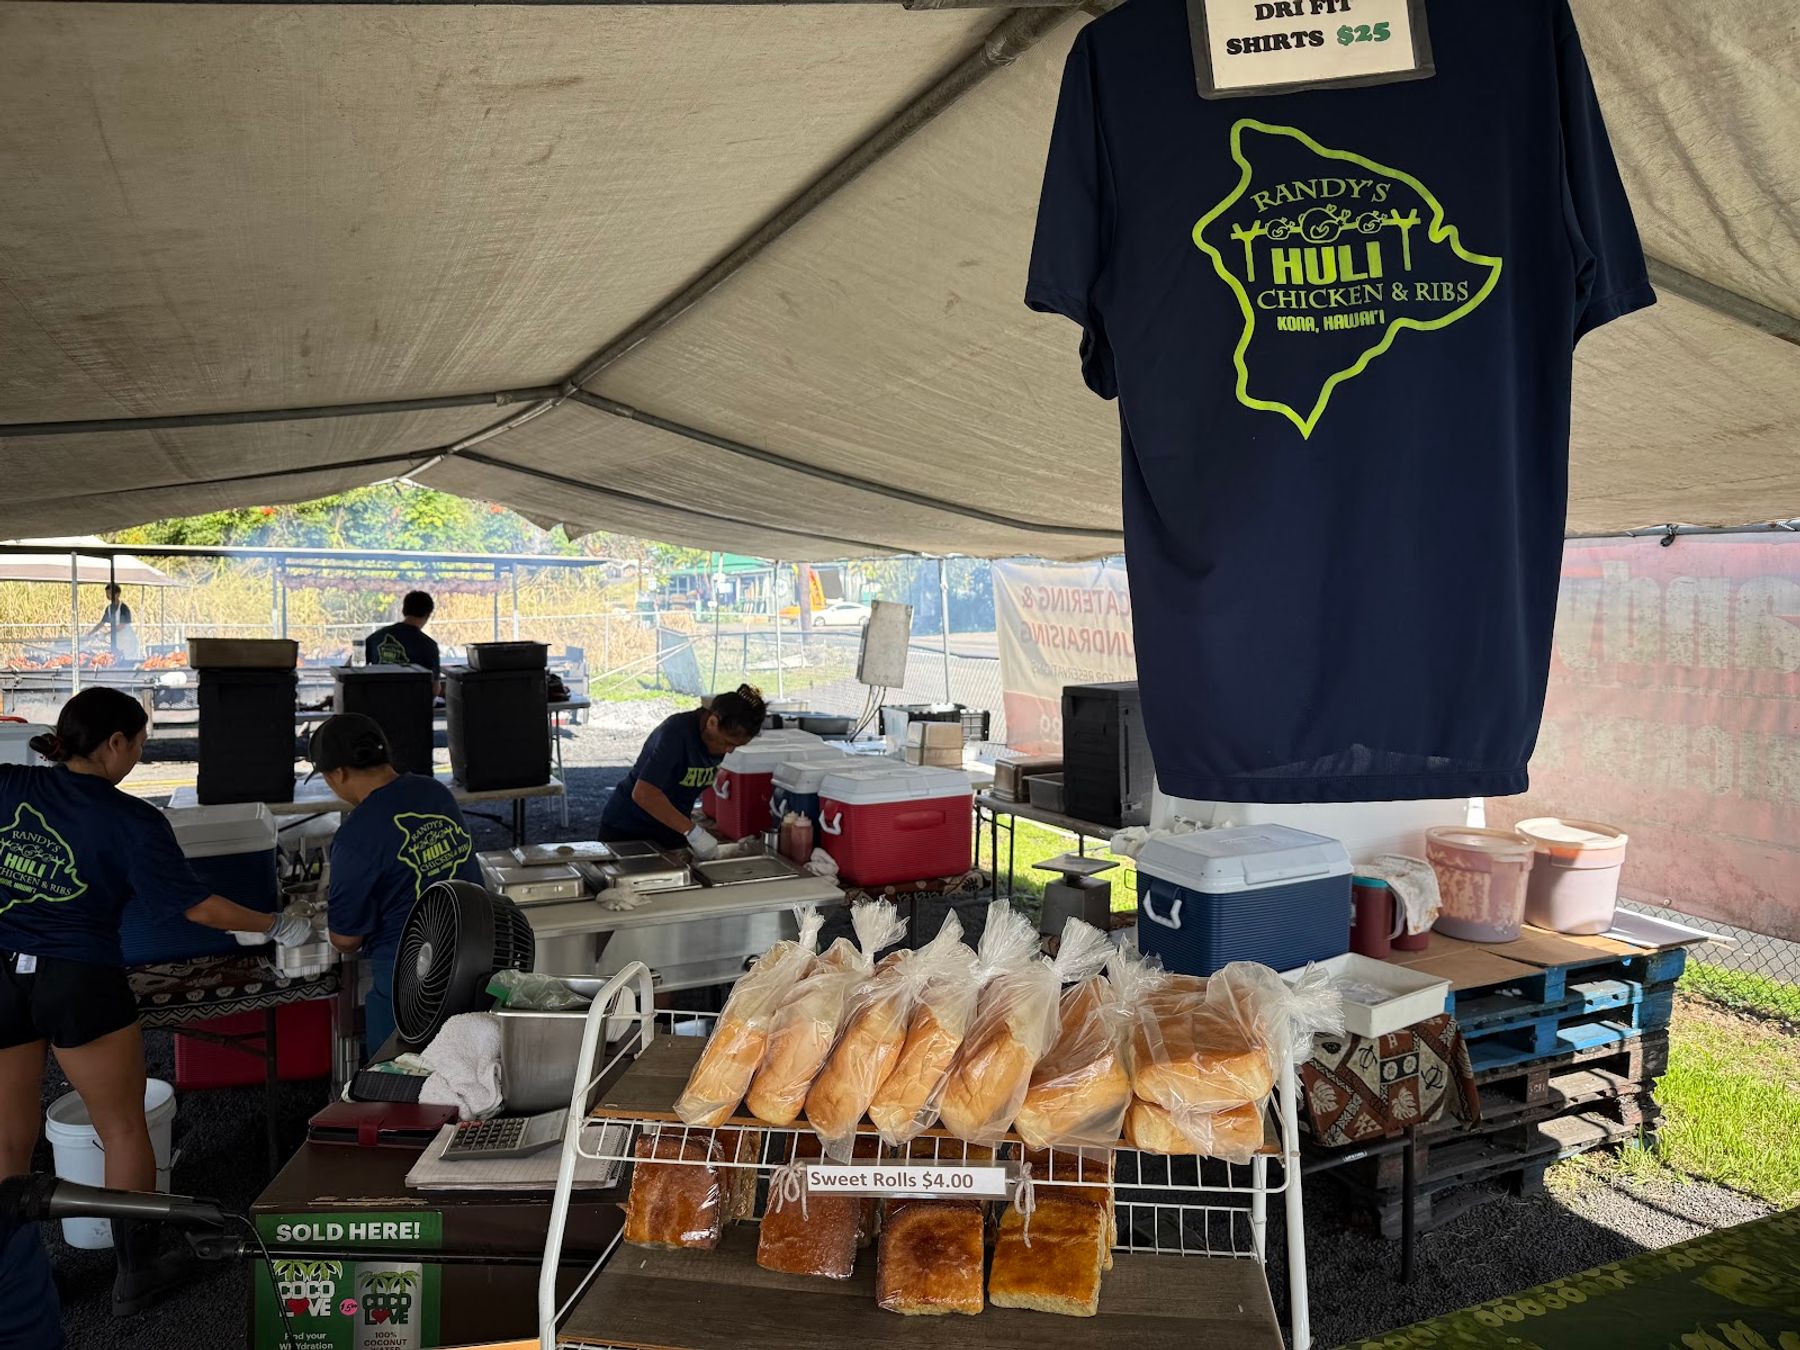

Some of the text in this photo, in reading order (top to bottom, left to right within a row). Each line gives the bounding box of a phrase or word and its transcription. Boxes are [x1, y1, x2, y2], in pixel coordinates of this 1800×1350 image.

[1254, 0, 1351, 21] DRI FIT
[1226, 21, 1391, 55] SHIRTS $25
[1250, 178, 1391, 213] RANDY'S
[1270, 241, 1383, 285] HULI
[1256, 280, 1469, 310] CHICKEN & RIBS
[12, 830, 61, 853] RANDY'S
[422, 839, 451, 863] HULI
[4, 852, 47, 878] HULI
[0, 866, 41, 886] HICKEN
[50, 883, 72, 896] RIBS
[811, 1171, 974, 1190] Sweet Rolls $4.00
[276, 1221, 420, 1242] SOLD HERE!
[278, 1280, 335, 1300] COCO
[362, 1293, 411, 1311] COCO
[284, 1332, 327, 1341] Fnd your
[363, 1338, 407, 1347] COCONUT
[375, 1331, 398, 1339] 100%
